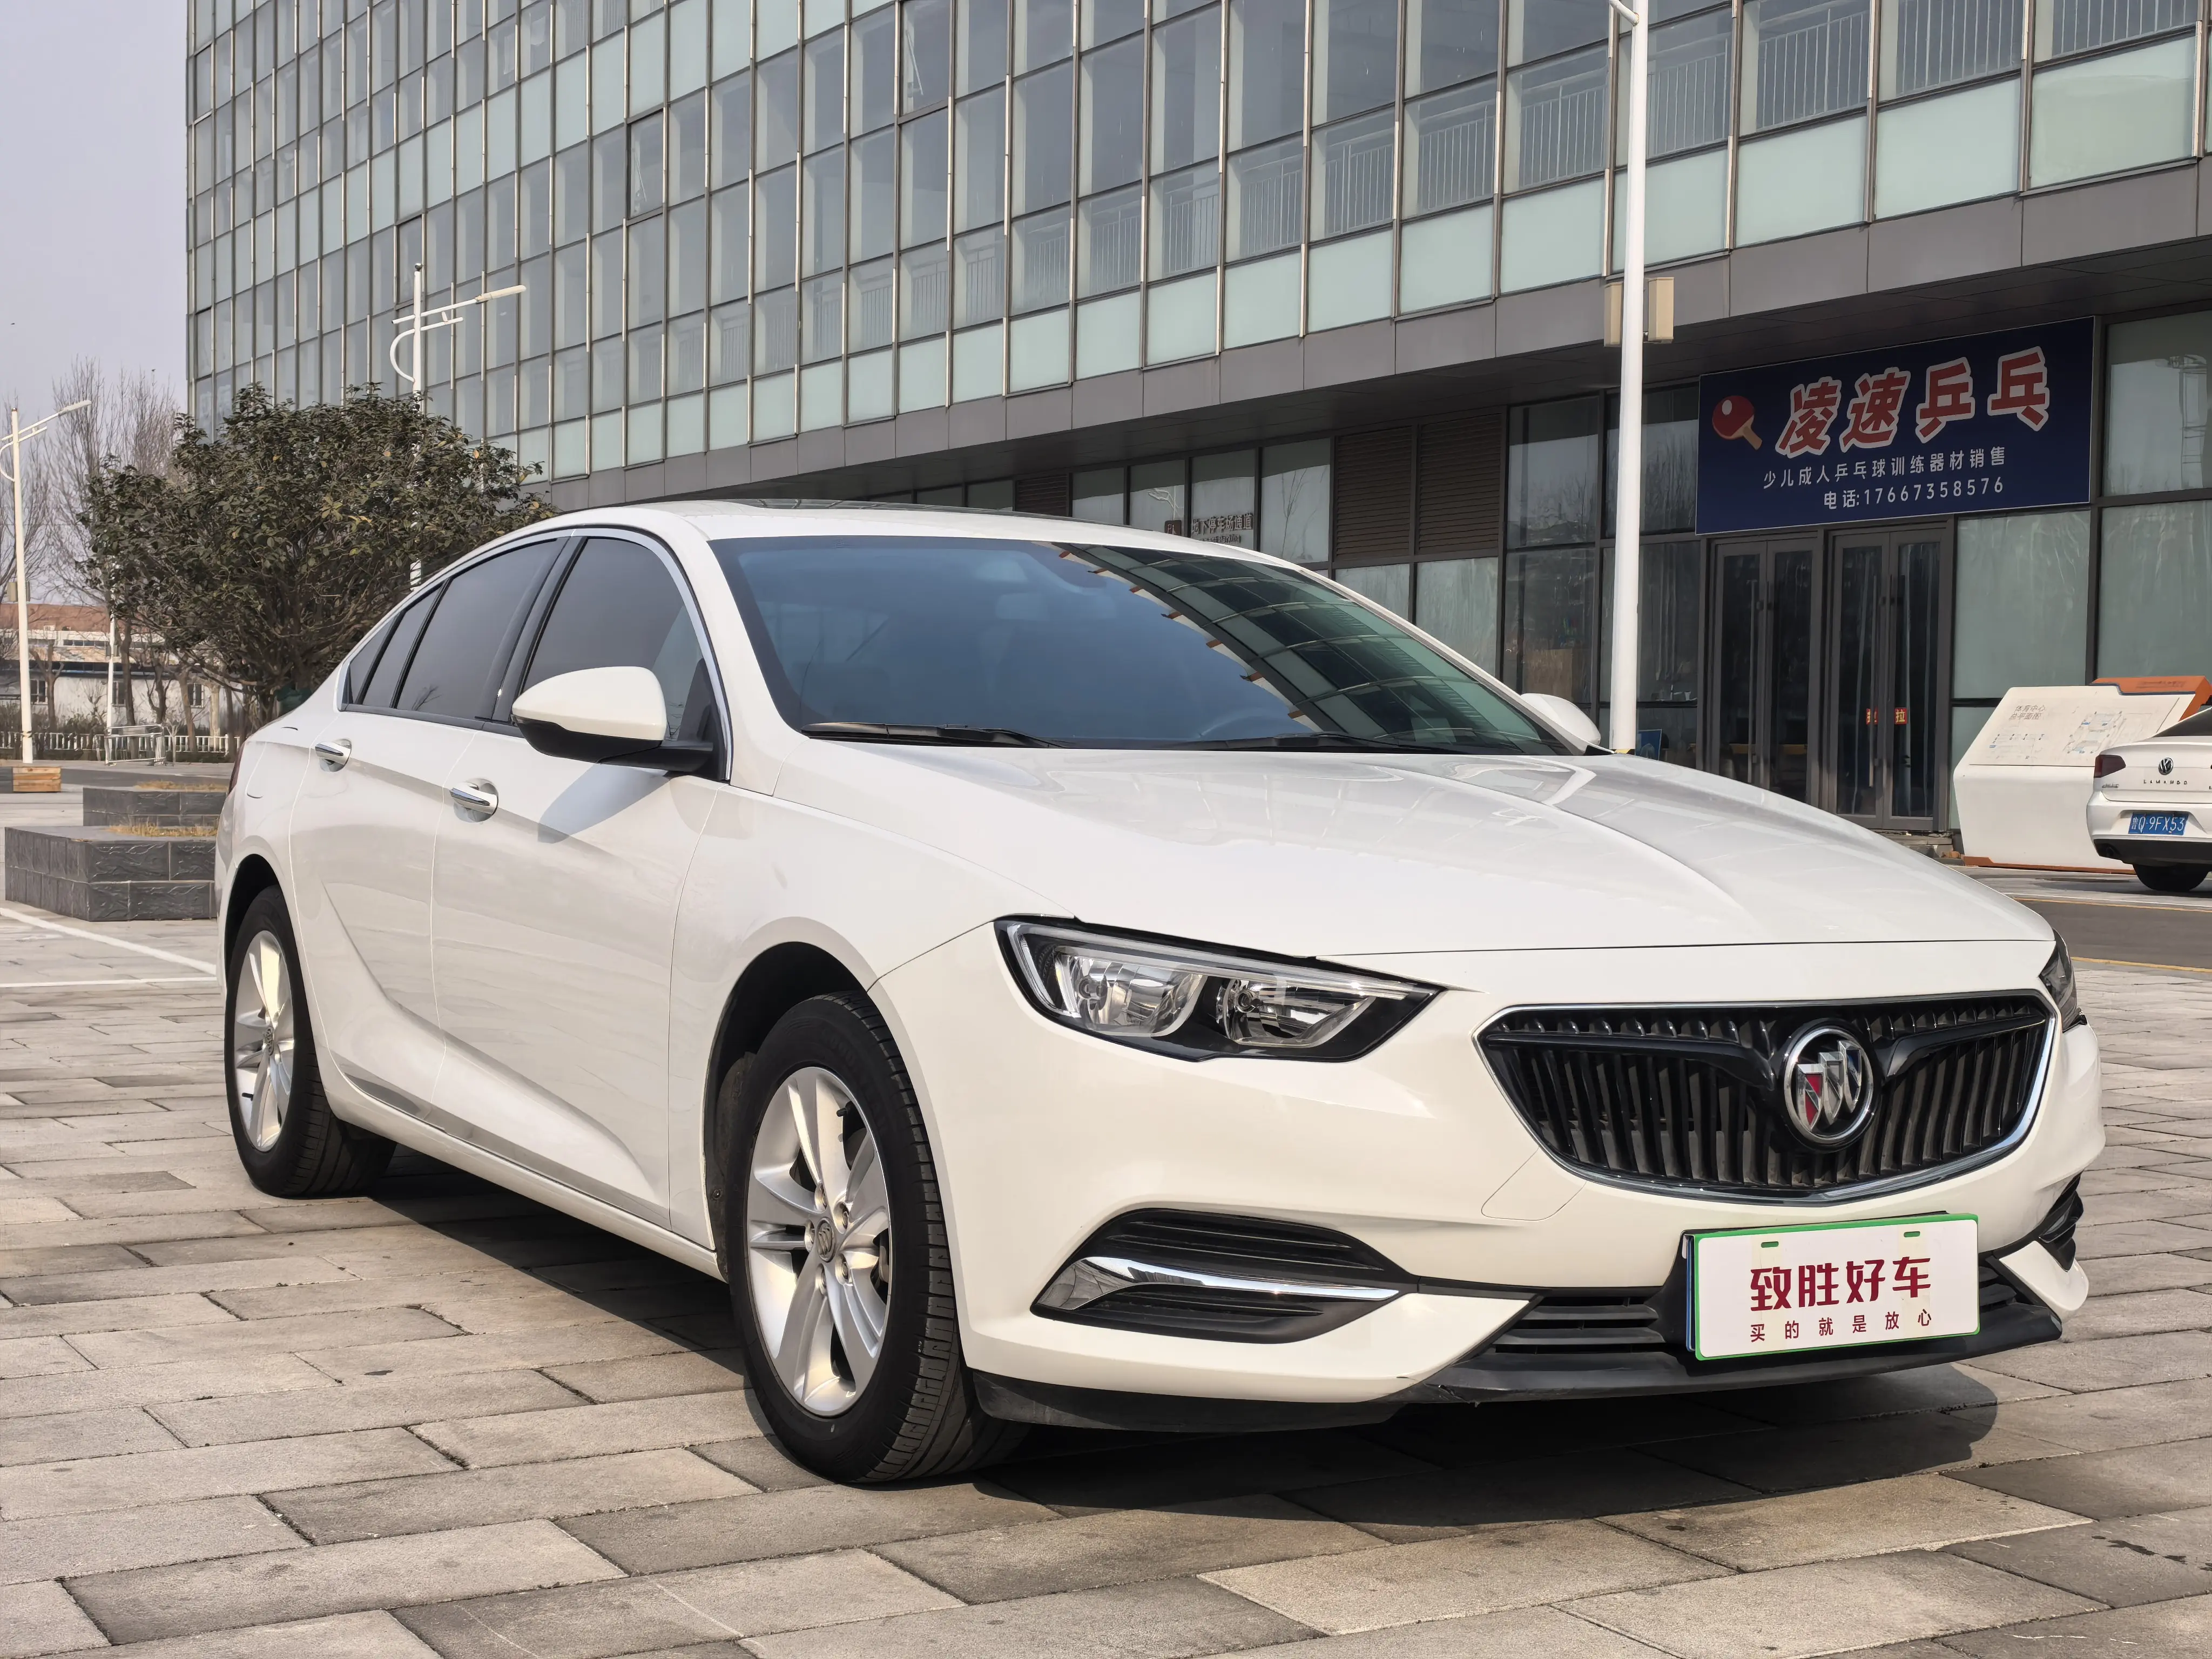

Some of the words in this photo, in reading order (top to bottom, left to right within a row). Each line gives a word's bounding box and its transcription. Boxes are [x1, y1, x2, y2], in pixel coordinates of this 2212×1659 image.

[1775, 346, 2050, 458] 凌速乒乓
[1763, 447, 2006, 489] 少儿成人乒乓球训练器材销售
[1823, 480, 2004, 509] 电话:17667358576
[1191, 512, 1253, 535] 地下停车场通道
[1750, 1256, 1931, 1311] 致胜好车
[1750, 1309, 1932, 1342] 买的就是放心
